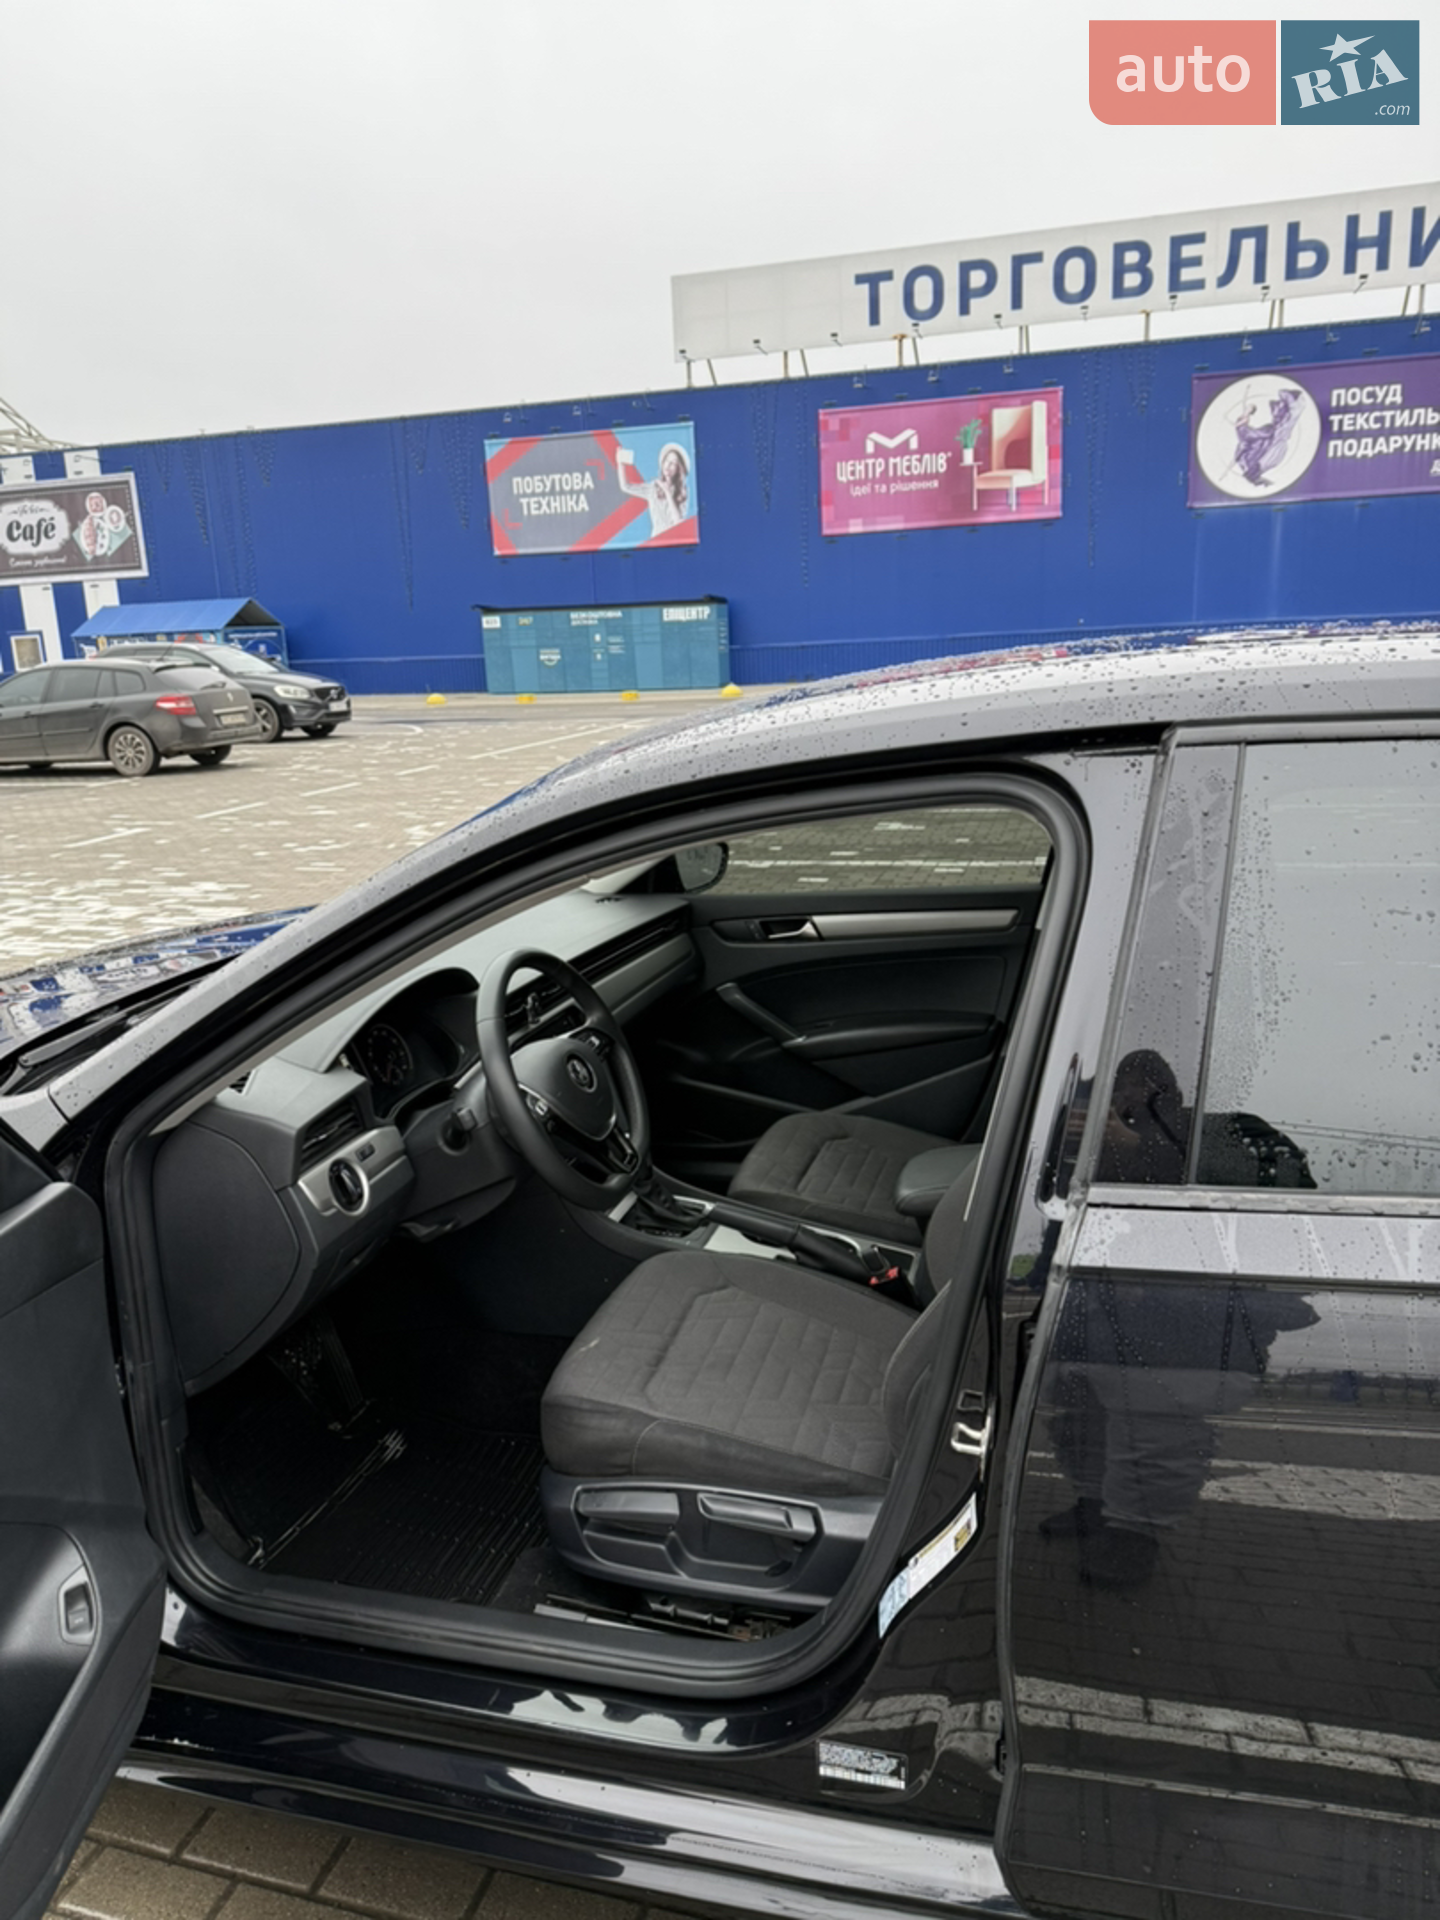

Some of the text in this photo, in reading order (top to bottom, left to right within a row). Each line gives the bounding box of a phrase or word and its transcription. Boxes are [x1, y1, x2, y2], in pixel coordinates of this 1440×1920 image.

[1331, 384, 1403, 407] ПОСУД
[1329, 407, 1440, 433] ТЕКСТИЛЬ
[836, 458, 885, 483] ЦЕНТР
[512, 471, 594, 495] ПОБУТОВА
[874, 483, 887, 494] та
[890, 479, 939, 494] рішення
[519, 493, 590, 516] ТЕХНІКА
[6, 516, 56, 548] Café
